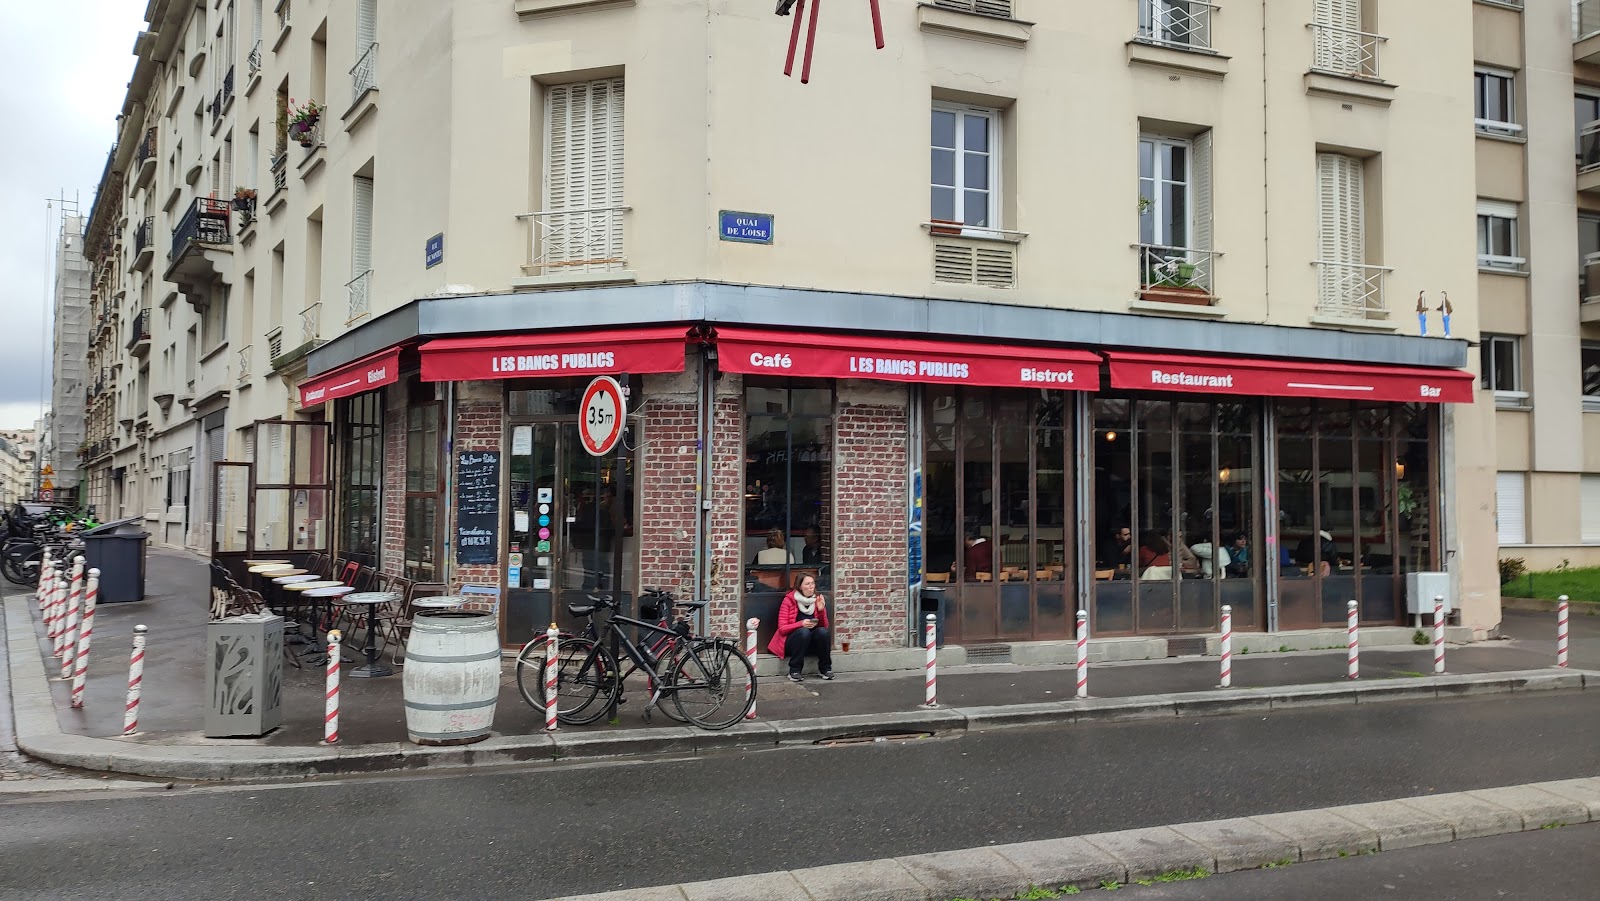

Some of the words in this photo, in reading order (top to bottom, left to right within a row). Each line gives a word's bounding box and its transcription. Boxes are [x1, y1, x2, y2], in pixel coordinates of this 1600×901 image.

[736, 218, 758, 227] QUAI
[727, 227, 739, 235] DE
[742, 227, 767, 238] L'OISE
[492, 356, 516, 372] LES
[517, 354, 559, 371] BANCS
[561, 352, 615, 369] PUBLICS
[749, 352, 793, 369] Café
[850, 356, 874, 373] LES
[875, 357, 916, 376] BANCS
[919, 360, 969, 378] PUBLICS
[1020, 368, 1074, 383] Bistrot
[1151, 369, 1233, 388] Restaurant
[1420, 384, 1442, 398] Bar
